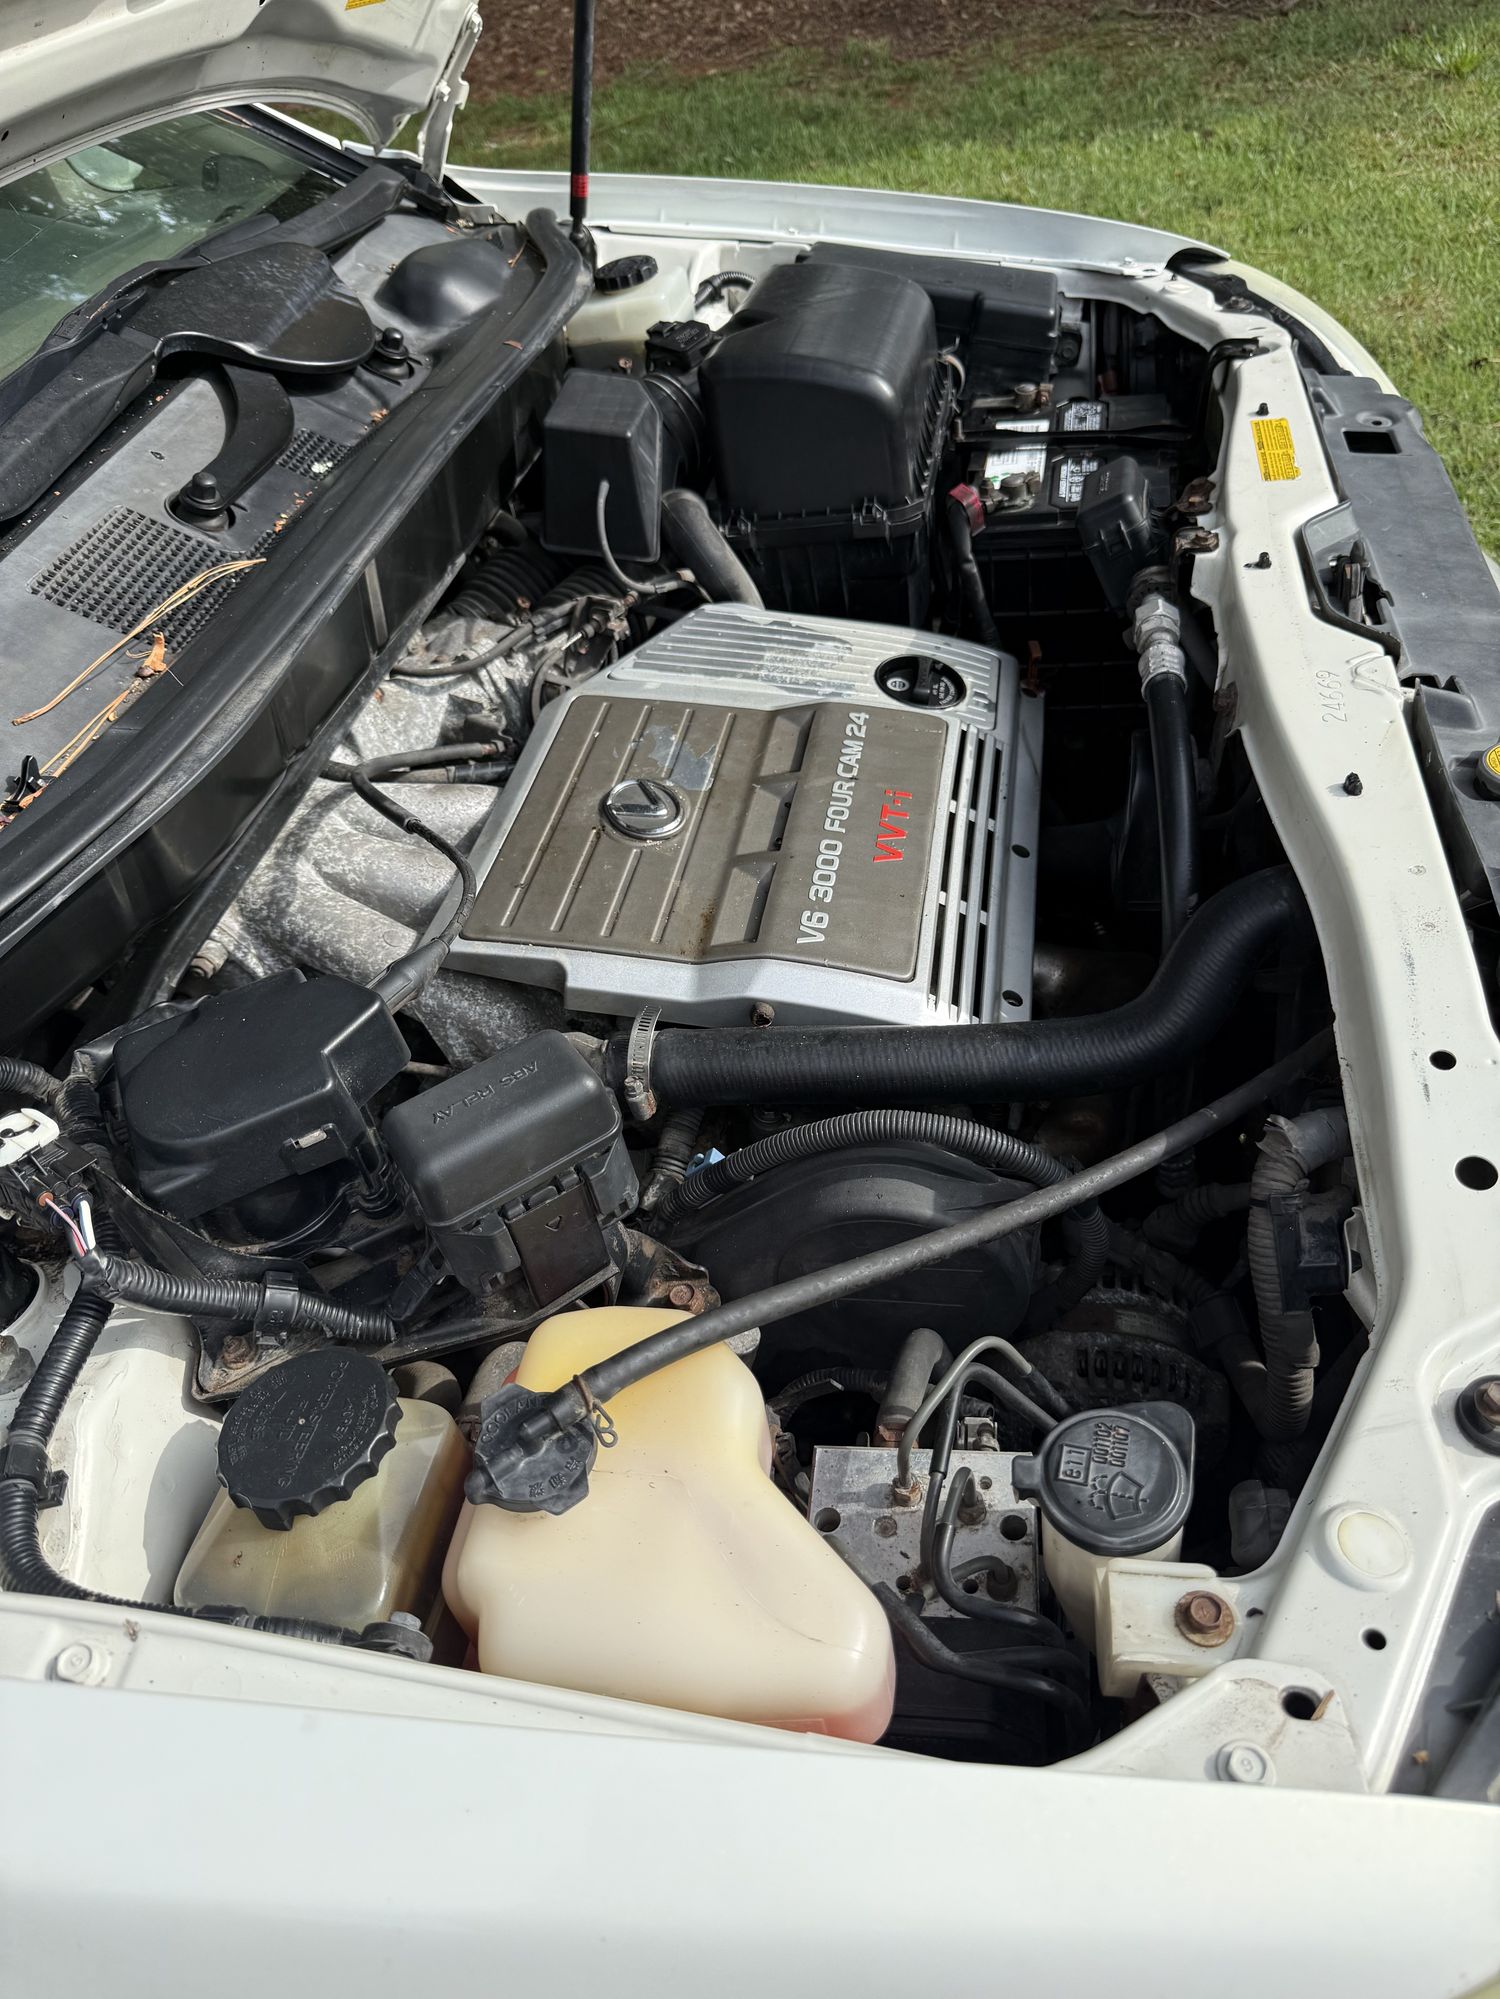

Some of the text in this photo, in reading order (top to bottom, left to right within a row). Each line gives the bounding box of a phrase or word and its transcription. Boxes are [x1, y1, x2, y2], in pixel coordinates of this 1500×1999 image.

[1315, 669, 1348, 723] 24669
[796, 711, 870, 945] V6 3000 FOUR CAM 24
[872, 788, 913, 863] VVT-i
[432, 1060, 539, 1126] ABS RELAY
[314, 1361, 350, 1409] POWER
[275, 1411, 322, 1489] STEERING
[1063, 1449, 1086, 1480] e11
[1092, 1422, 1115, 1465] 001102
[1108, 1424, 1131, 1468] 001107
